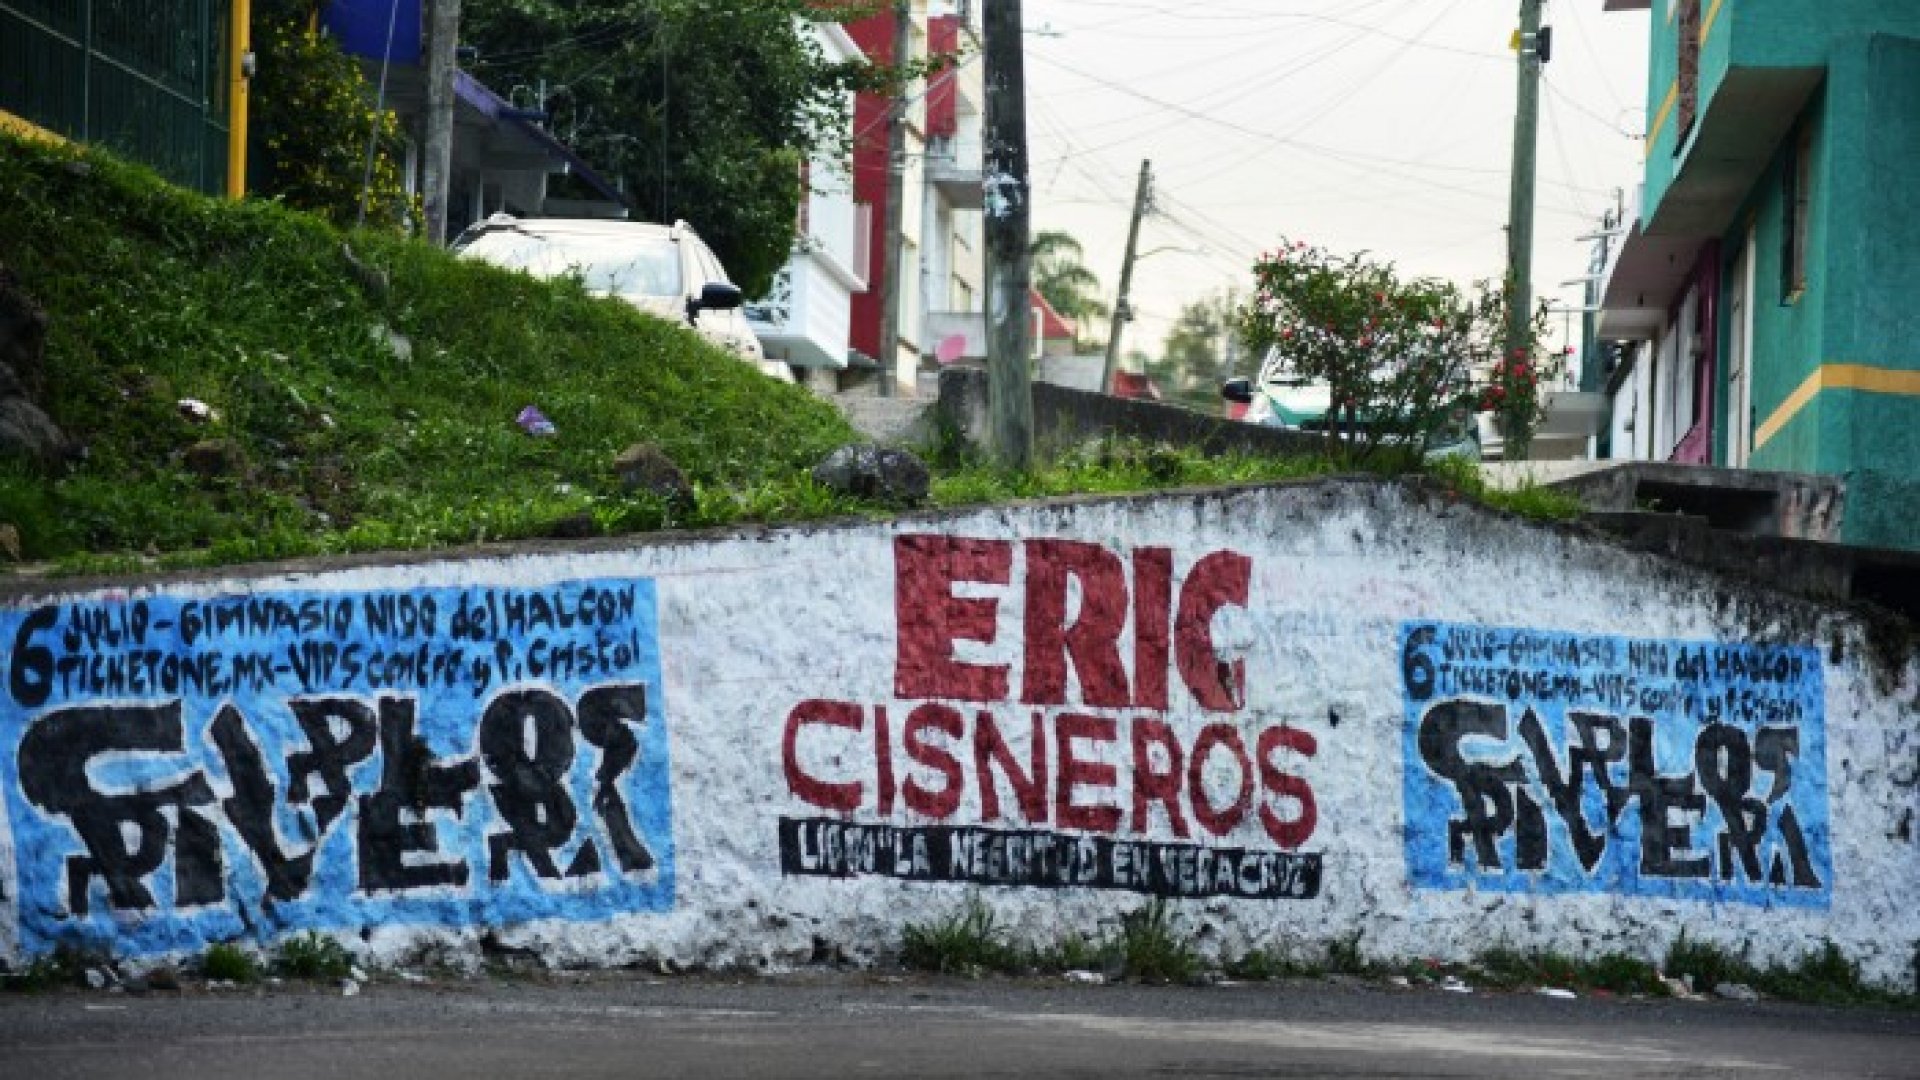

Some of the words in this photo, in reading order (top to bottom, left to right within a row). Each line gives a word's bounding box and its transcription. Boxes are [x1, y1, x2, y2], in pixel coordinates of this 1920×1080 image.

[10, 604, 59, 707] 6
[363, 591, 437, 640] NIDO
[451, 588, 498, 642] del
[503, 583, 635, 637] HALCON
[894, 533, 1252, 711] ERIC
[1403, 624, 1436, 700] 6
[782, 698, 1318, 849] CISNEROS
[1112, 841, 1150, 886] EN
